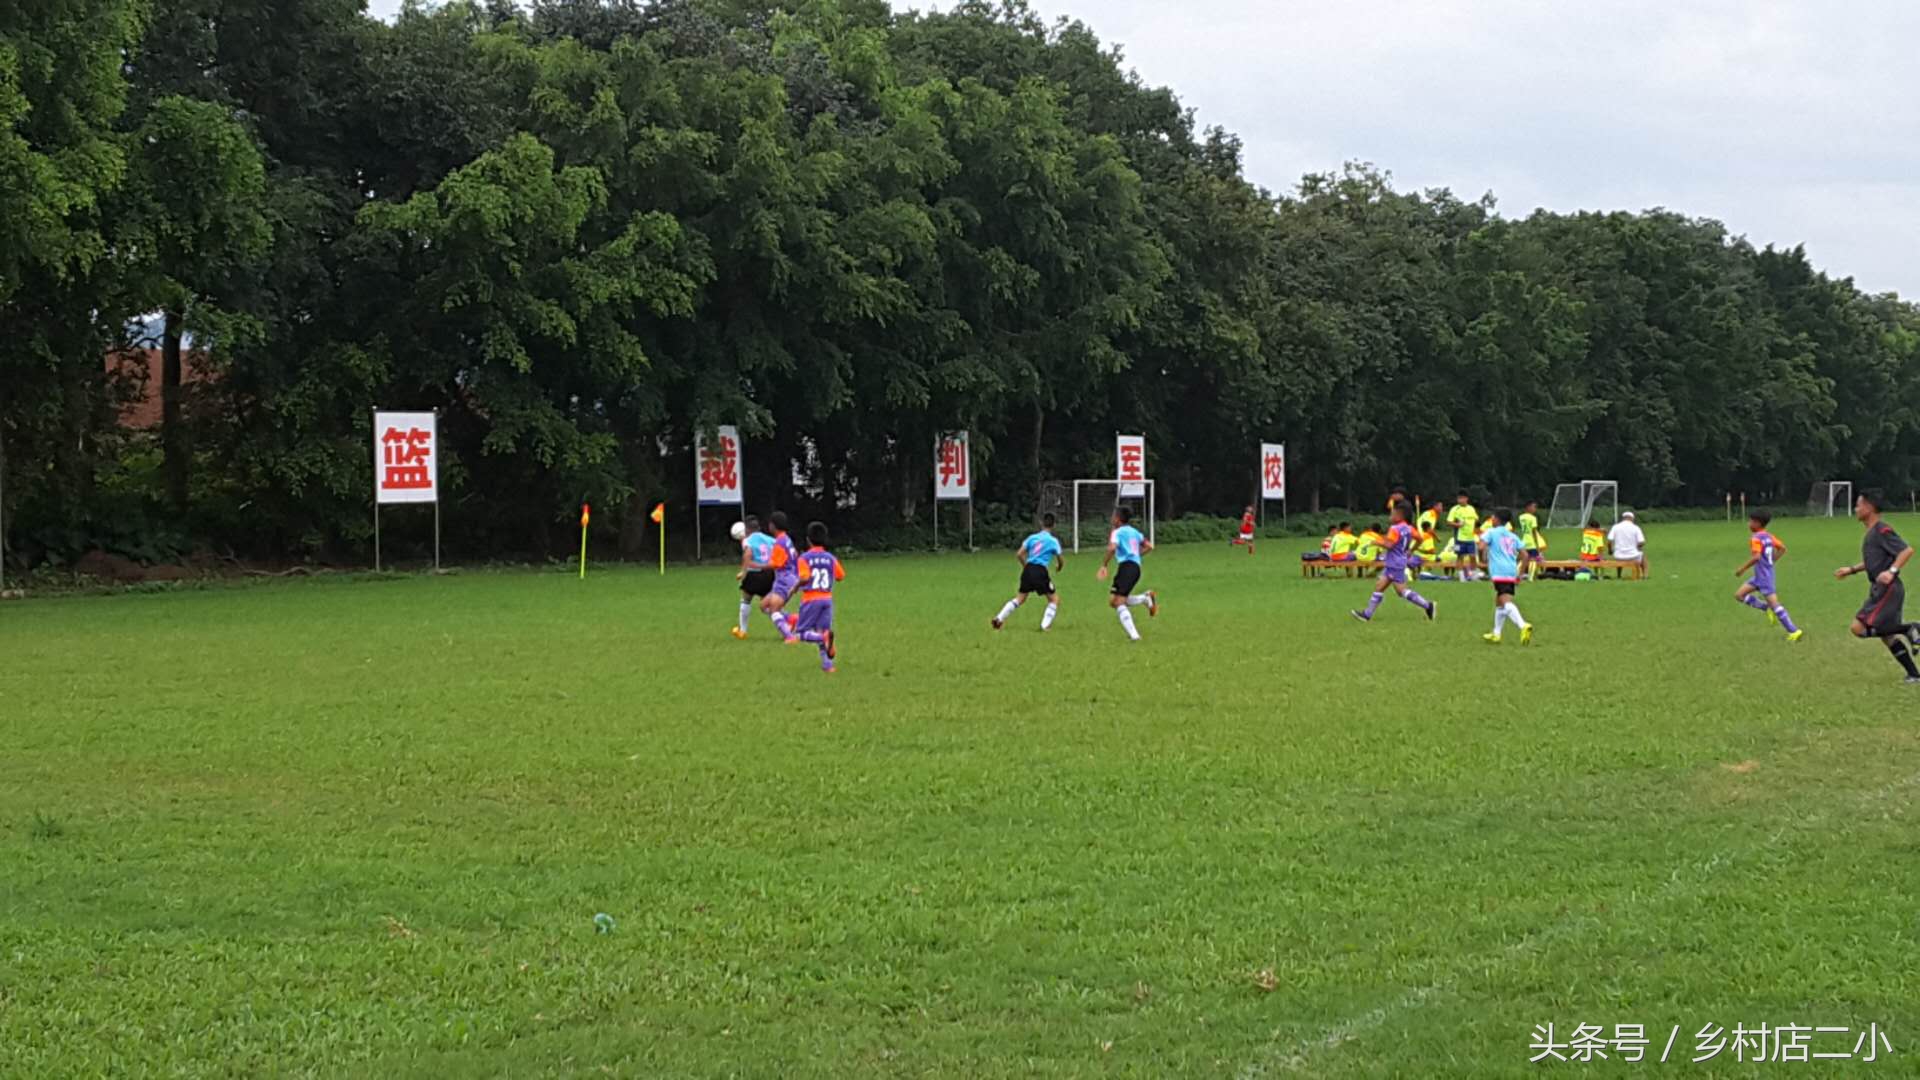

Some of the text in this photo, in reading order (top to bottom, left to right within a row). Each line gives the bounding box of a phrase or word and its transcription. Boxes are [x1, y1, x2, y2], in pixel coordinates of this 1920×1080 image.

[381, 427, 432, 489] 篮
[937, 440, 966, 487] 判
[1120, 445, 1142, 484] 军
[1264, 451, 1282, 490] 校
[811, 567, 829, 589] 23
